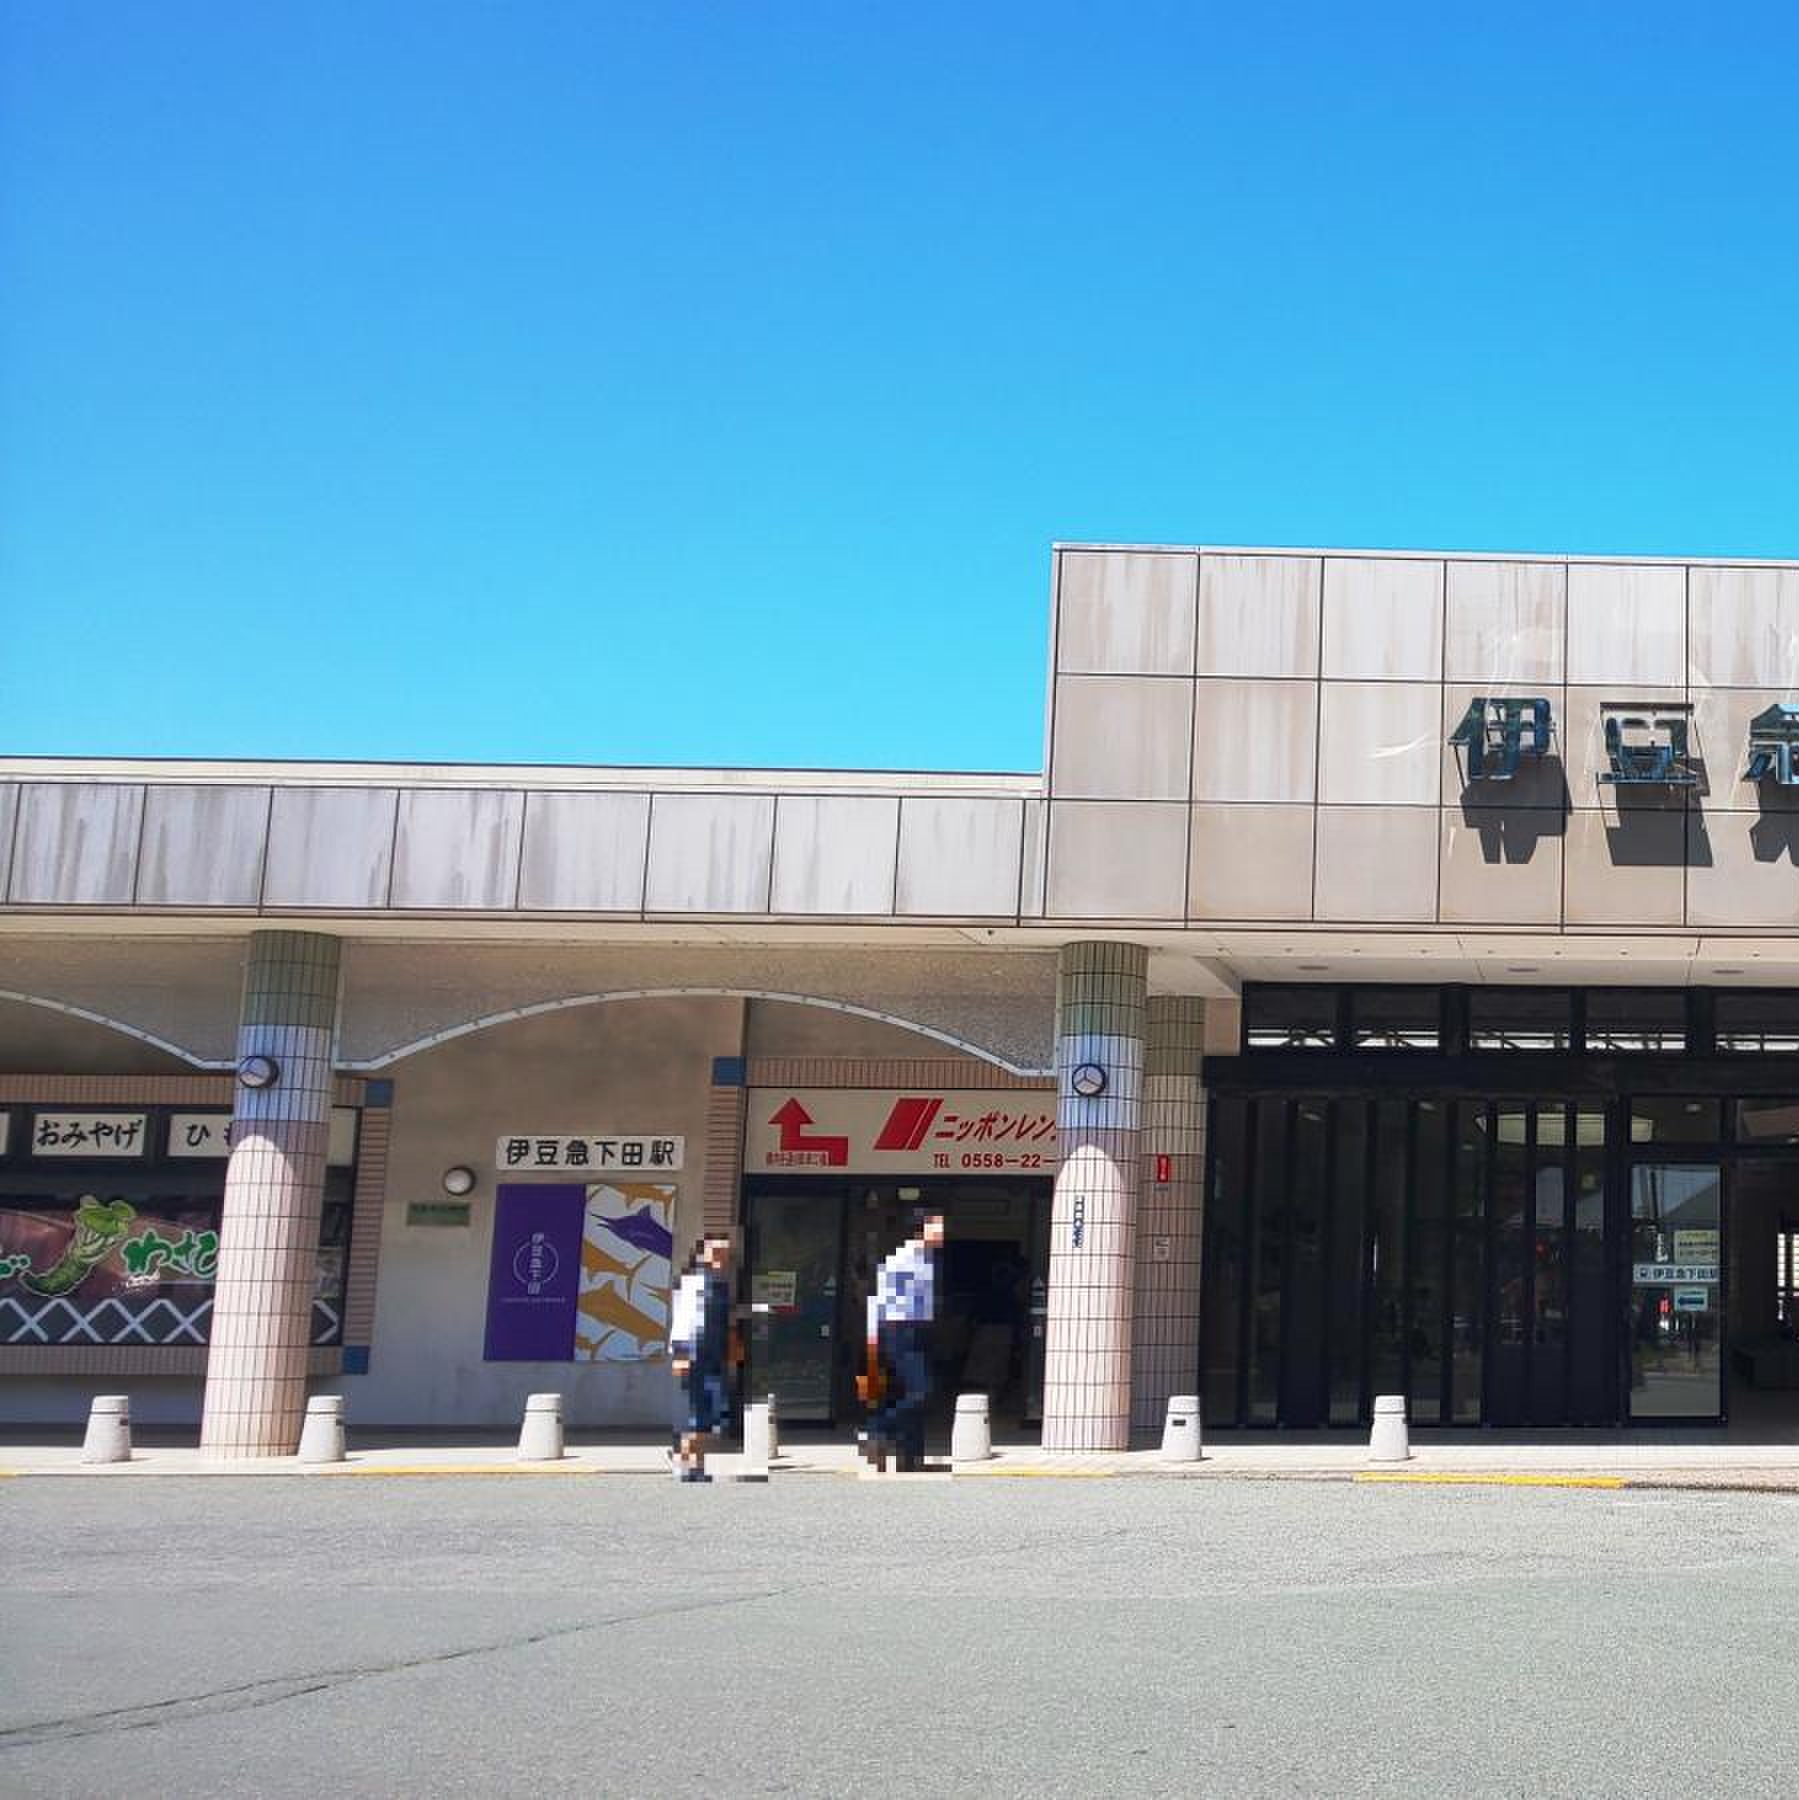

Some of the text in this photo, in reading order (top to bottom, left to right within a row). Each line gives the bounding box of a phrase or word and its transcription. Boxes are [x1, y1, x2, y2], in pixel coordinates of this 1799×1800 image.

[37, 1119, 143, 1148] おみやげ
[935, 1110, 1056, 1142] ニッポンレン
[505, 1139, 675, 1166] 伊豆急下田駅
[934, 1153, 950, 1168] TEL
